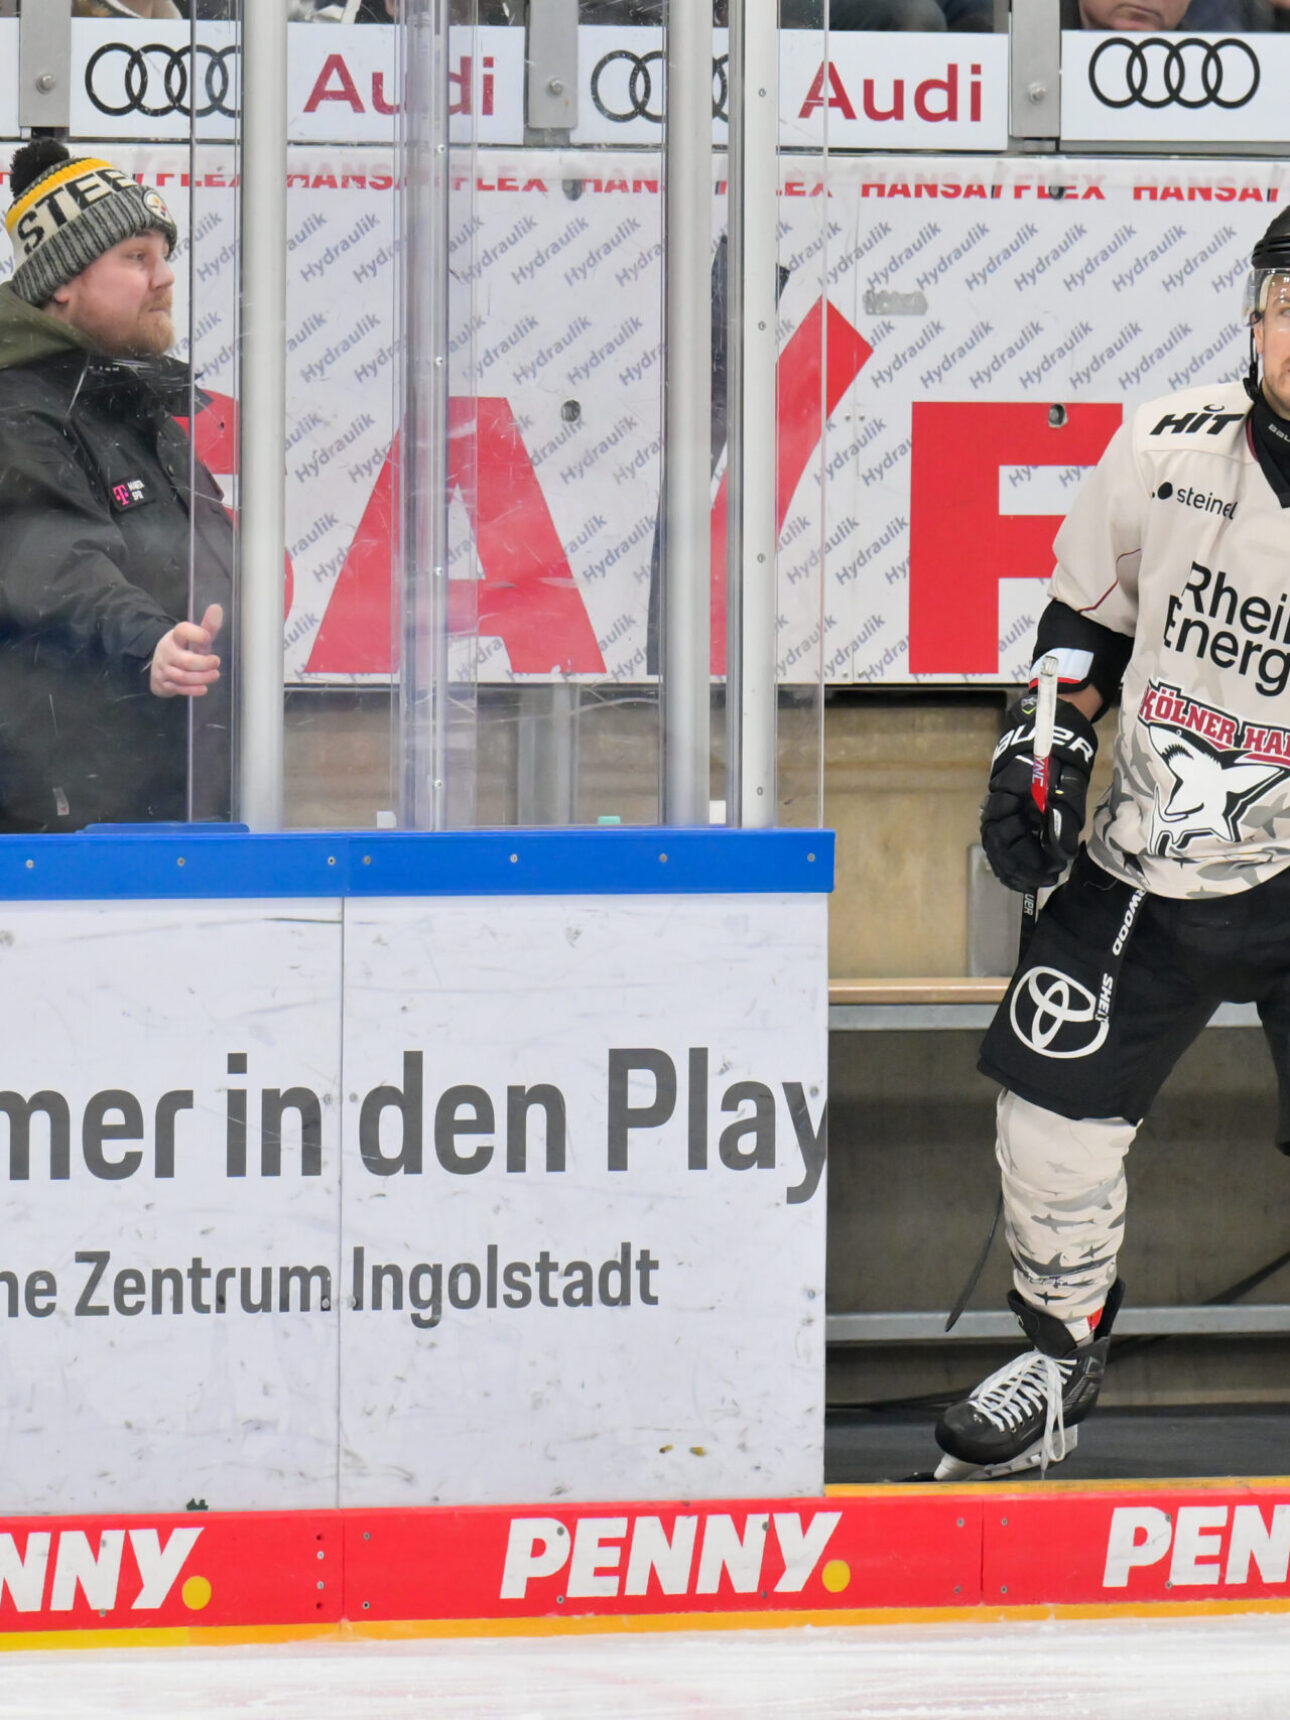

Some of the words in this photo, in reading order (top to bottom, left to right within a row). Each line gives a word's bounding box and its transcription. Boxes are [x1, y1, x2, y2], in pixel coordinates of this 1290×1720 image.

[798, 61, 982, 122] Audi
[18, 168, 139, 256] STEE
[169, 212, 223, 263] draulik
[287, 212, 327, 251] aulik
[447, 215, 485, 253] aulik
[300, 213, 380, 283] Hydraulik
[460, 215, 538, 285] Hydraulik
[511, 216, 590, 285] Hydraulik
[563, 217, 642, 287] Hydraulik
[866, 222, 942, 290] Hydraulik
[915, 222, 990, 290] Hydraulik
[965, 222, 1039, 291] Hydraulik
[1014, 223, 1089, 292] Hydraulik
[1063, 223, 1138, 292] Hydraulik
[1112, 224, 1187, 293] Hydraulik
[1162, 225, 1237, 293] Hydraulik
[287, 311, 327, 352] aulik
[300, 312, 381, 384] Hydraulik
[447, 315, 486, 353] aulik
[512, 315, 592, 386] Hydraulik
[566, 316, 643, 386] Hydraulik
[870, 319, 945, 389] Hydraulik
[919, 319, 994, 389] Hydraulik
[969, 320, 1044, 390] Hydraulik
[1019, 320, 1094, 390] Hydraulik
[1069, 321, 1143, 390] Hydraulik
[1118, 321, 1193, 391] Hydraulik
[1168, 322, 1242, 391] Hydraulik
[283, 412, 323, 452] aulik
[294, 412, 376, 484] Hydraulik
[560, 415, 639, 485] Hydraulik
[1149, 404, 1245, 435] HIT
[861, 440, 912, 487] Hydra
[288, 511, 339, 561] raulik
[561, 513, 608, 561] raulik
[1177, 487, 1238, 520] steinel
[835, 515, 909, 586] Hydraulik
[282, 611, 320, 652] aulik
[600, 613, 637, 653] aulik
[998, 613, 1036, 653] aulik
[1139, 688, 1236, 751] KÖLNER
[226, 1053, 323, 1178] in
[359, 1051, 566, 1176] den
[607, 1046, 828, 1205] Play
[74, 1251, 331, 1317] Zentrum
[351, 1242, 659, 1328] Ingolstadt
